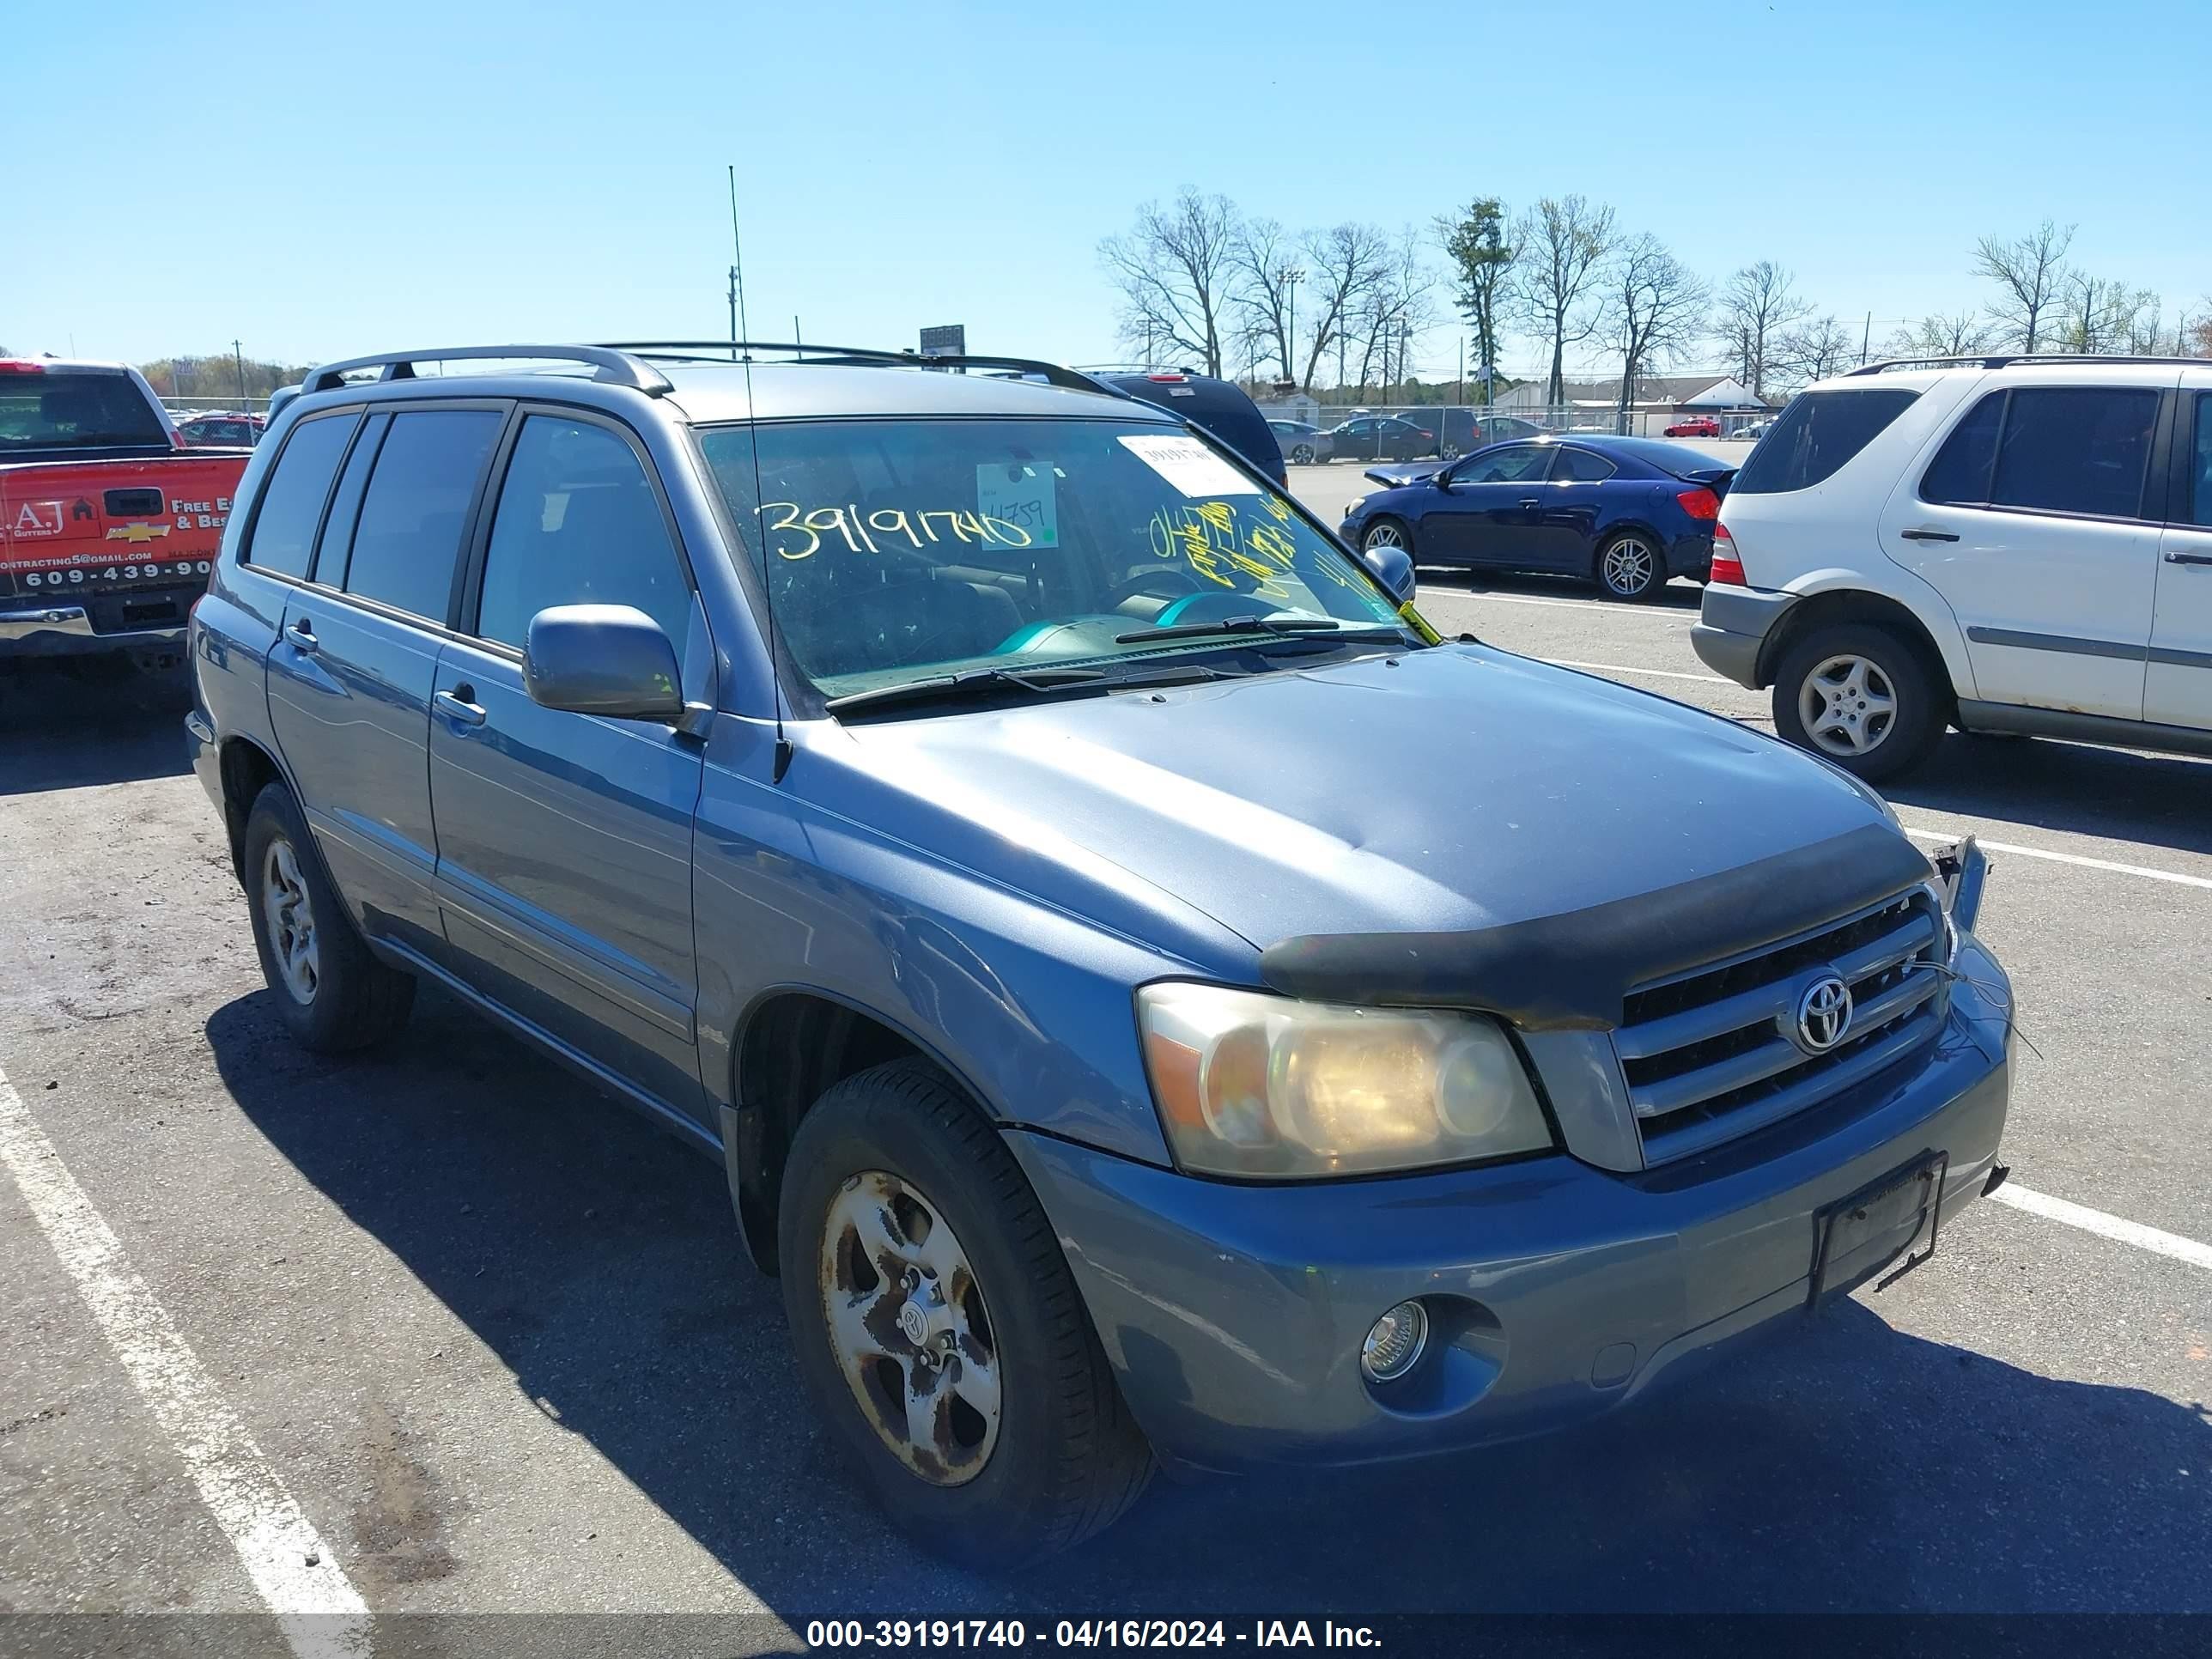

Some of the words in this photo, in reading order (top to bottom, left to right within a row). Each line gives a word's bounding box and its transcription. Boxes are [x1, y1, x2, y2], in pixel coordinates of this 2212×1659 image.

[216, 497, 233, 512] E
[177, 515, 192, 530] &
[754, 501, 1033, 561] 39191740
